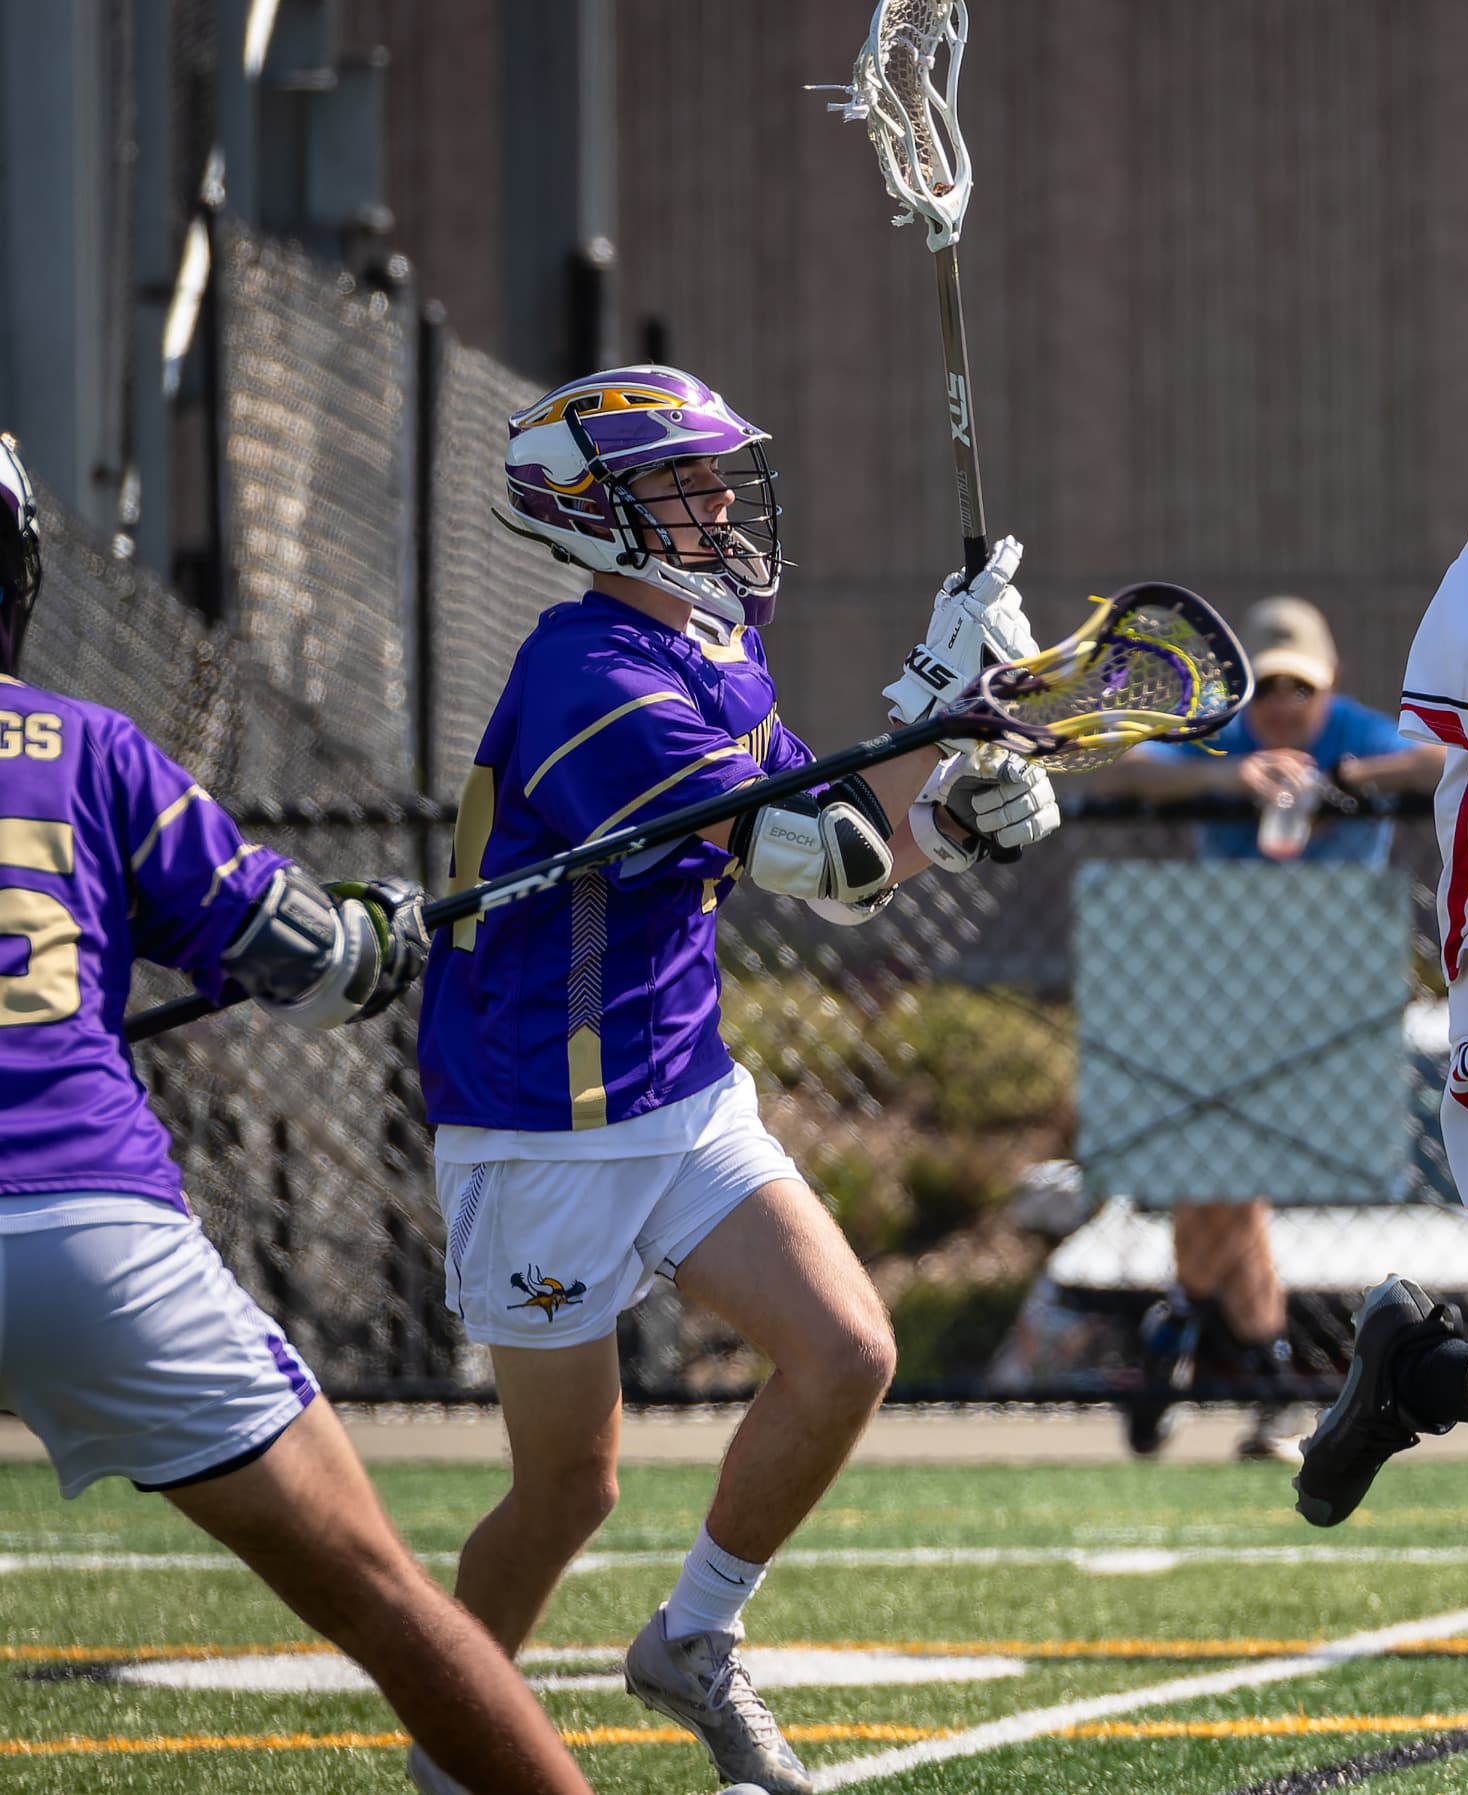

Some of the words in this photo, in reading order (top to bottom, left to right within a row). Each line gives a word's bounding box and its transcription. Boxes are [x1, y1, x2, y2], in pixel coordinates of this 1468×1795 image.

[947, 371, 971, 448] STX
[905, 648, 958, 690] STX
[769, 826, 815, 848] EPOCH
